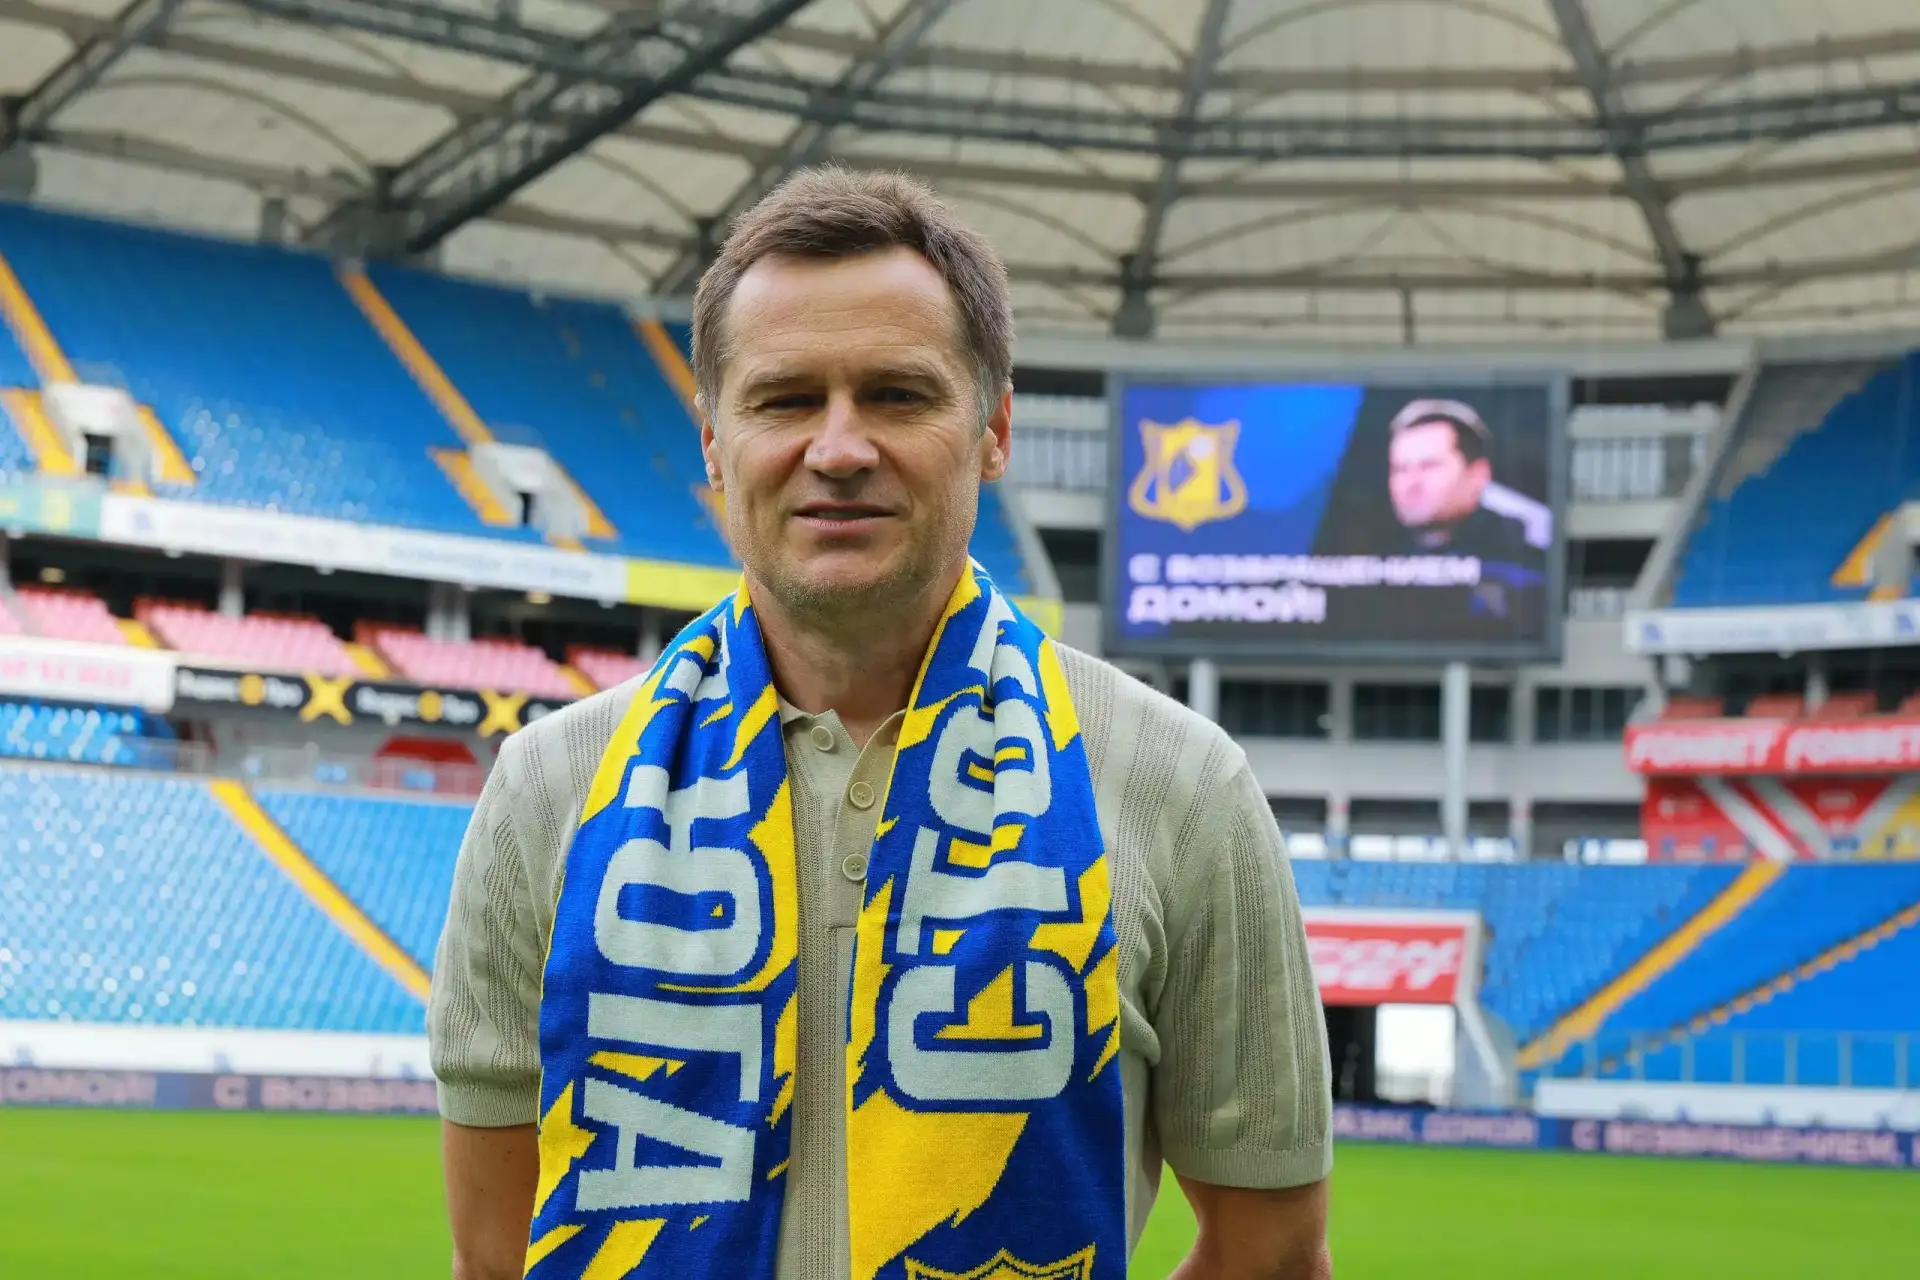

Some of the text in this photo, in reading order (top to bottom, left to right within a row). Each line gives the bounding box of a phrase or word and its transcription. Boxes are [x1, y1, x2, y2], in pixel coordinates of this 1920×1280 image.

[1129, 554, 1481, 586] С ВОЗВРАЩЕНИЕМ
[1127, 580, 1327, 624] ДОМОЙ!
[575, 764, 763, 1212] ЮГА
[0, 1072, 156, 1104] ОМОЙ
[214, 1075, 250, 1109] С
[1572, 1121, 1598, 1151] С
